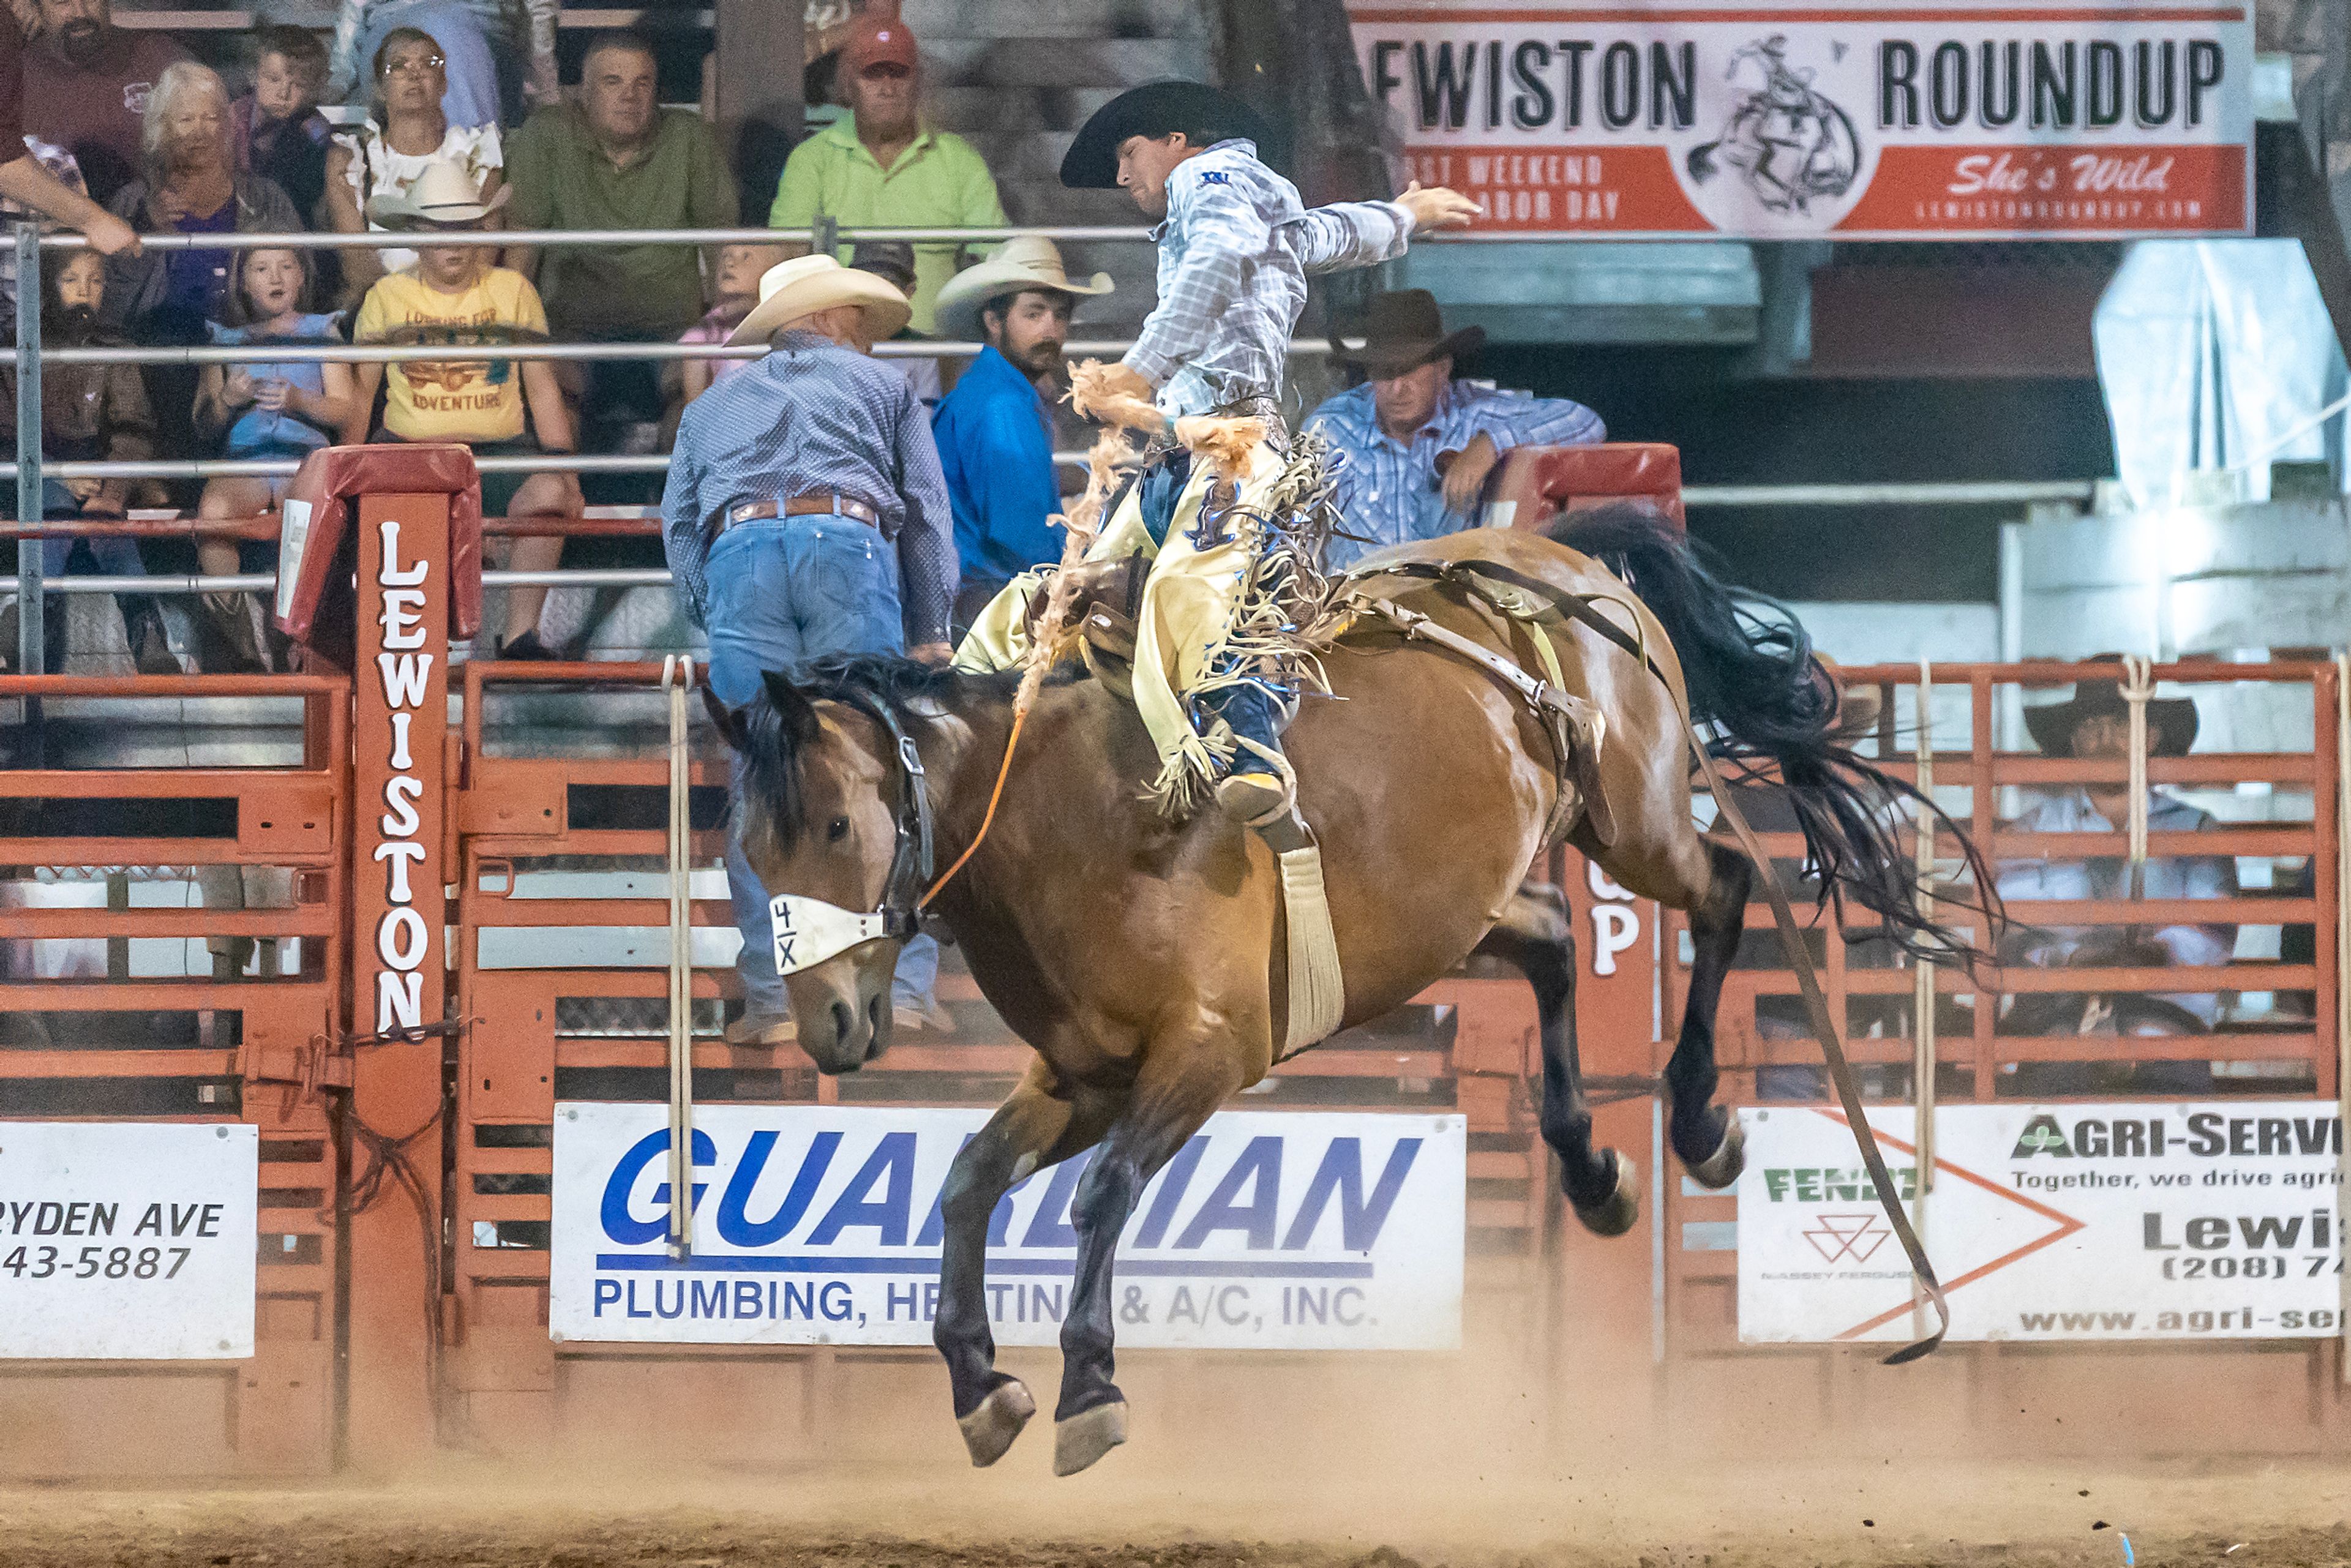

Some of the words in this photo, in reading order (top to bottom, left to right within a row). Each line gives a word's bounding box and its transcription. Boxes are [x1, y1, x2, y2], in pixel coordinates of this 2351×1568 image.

[1878, 39, 2224, 129] ROUNDUP
[1469, 155, 1602, 185] WEEKEND
[1947, 152, 2057, 195] She's
[2071, 153, 2175, 193] Wild
[1473, 190, 1551, 222] ABOR
[1567, 190, 1618, 221] DAY
[375, 520, 433, 1041] LEWISTON
[2010, 1170, 2141, 1191] Together,
[2150, 1174, 2192, 1187] we
[2203, 1169, 2272, 1187] drive
[133, 1203, 224, 1238] AVE
[2, 1246, 192, 1280] 43-5887
[1837, 1270, 1913, 1280] FERGUS
[2162, 1256, 2287, 1280] (208)
[594, 1278, 867, 1329] PLUMBING,
[887, 1283, 1074, 1323] HETIN
[1119, 1285, 1150, 1324] &
[1166, 1285, 1262, 1332] A/C,
[1283, 1286, 1378, 1327] INC.
